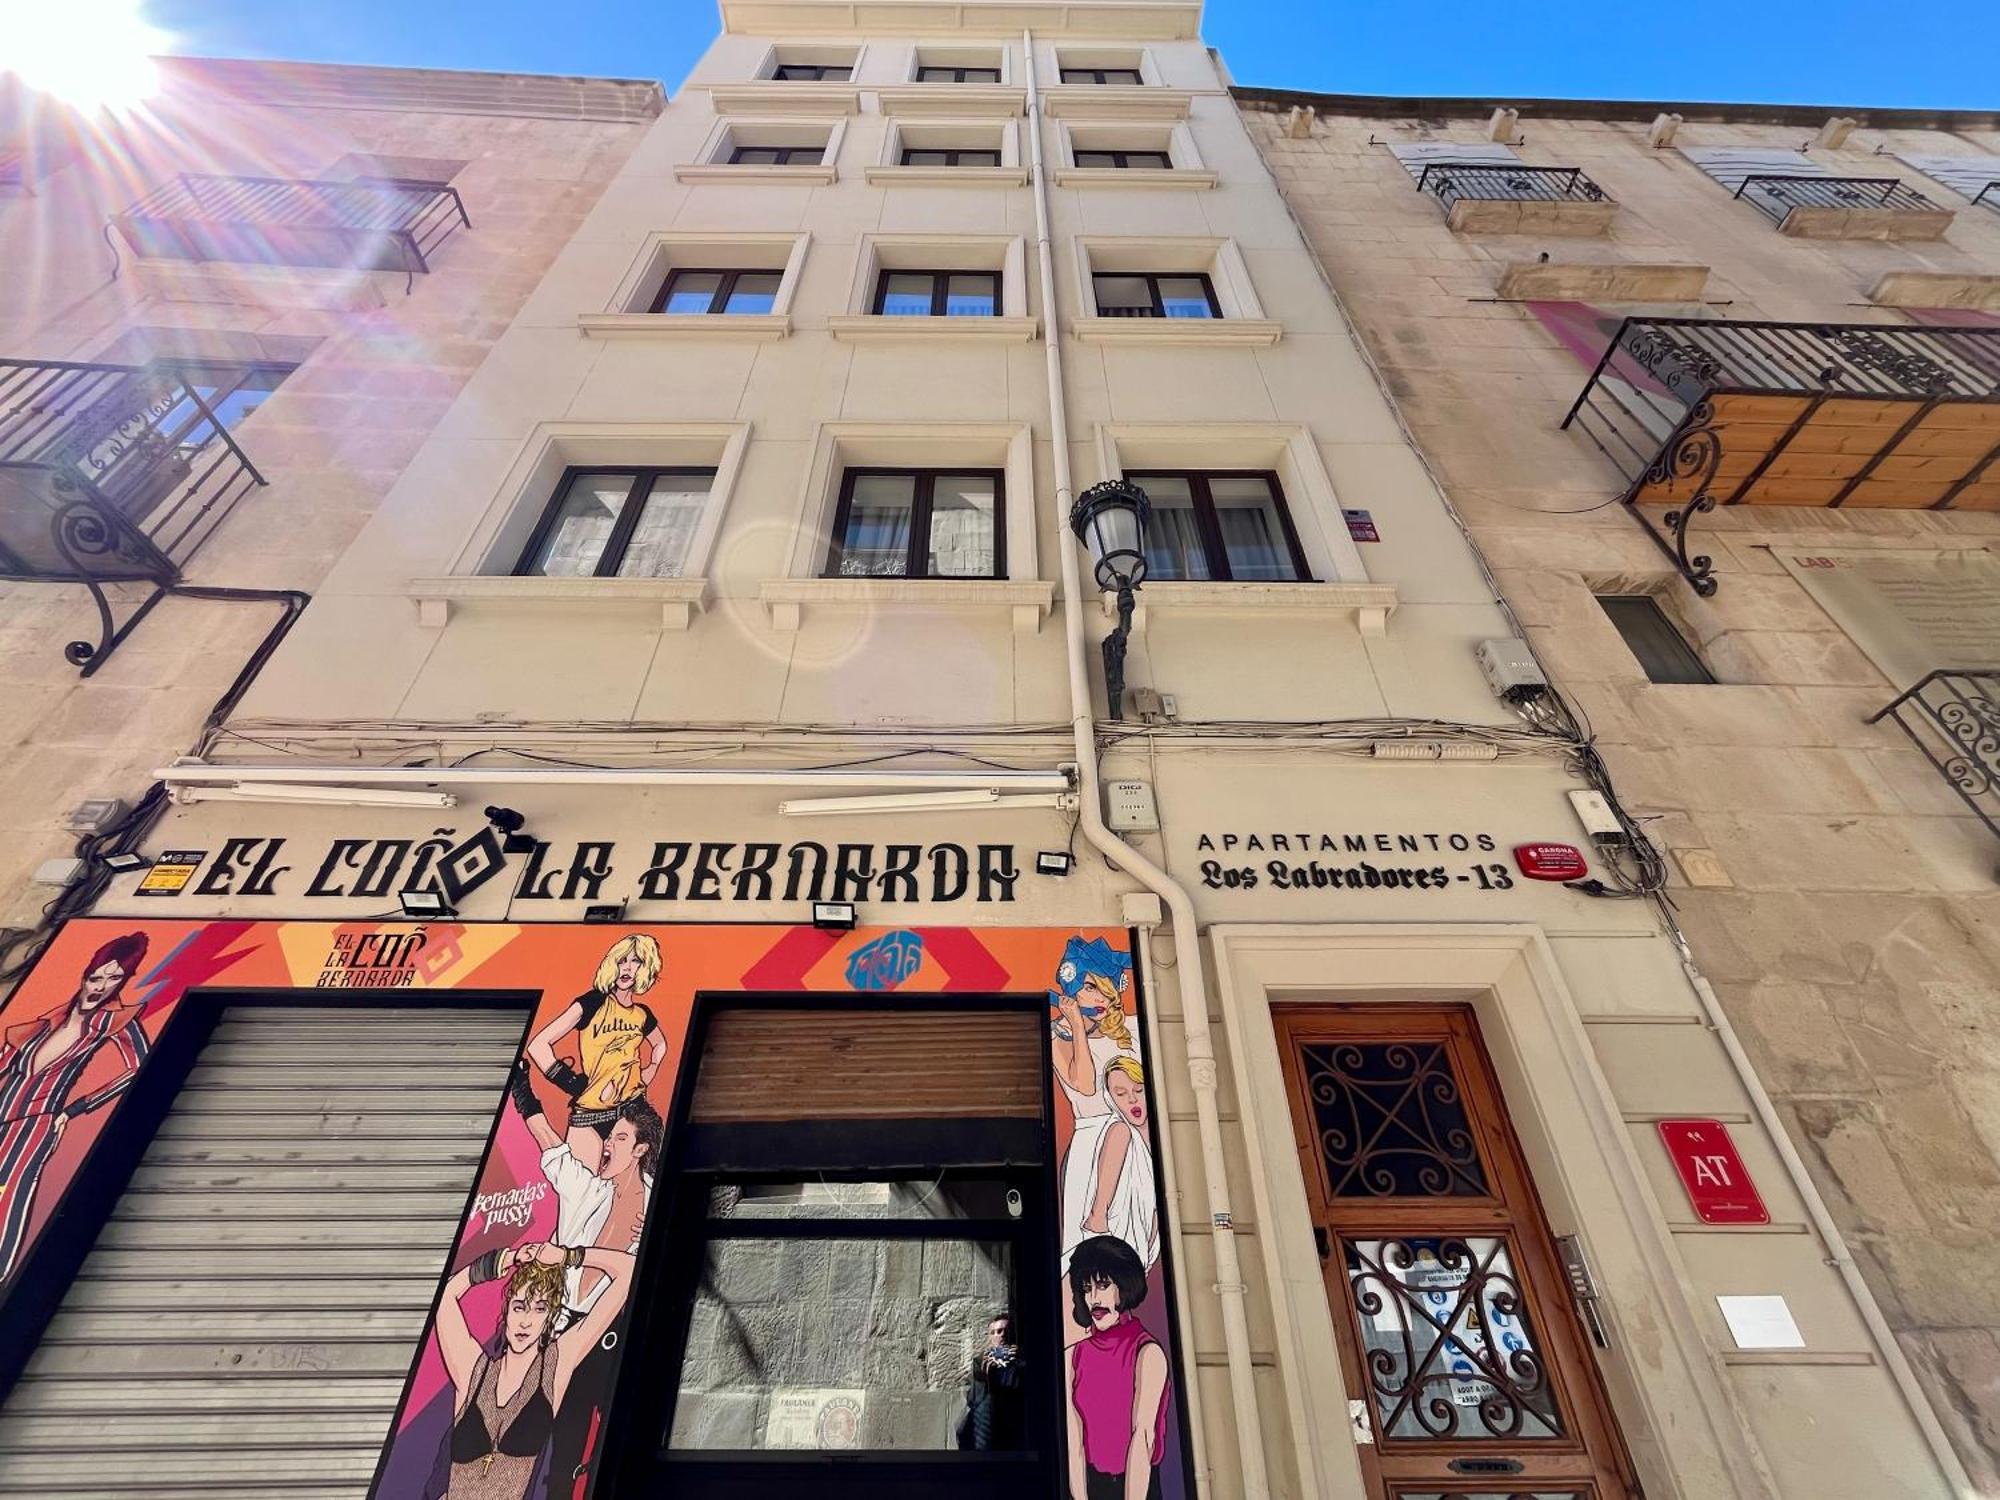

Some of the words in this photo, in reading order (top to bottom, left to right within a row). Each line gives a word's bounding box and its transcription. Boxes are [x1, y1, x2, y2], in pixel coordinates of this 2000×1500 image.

[1197, 833, 1497, 852] APARTAMENTOS
[191, 837, 292, 896] EL
[514, 841, 616, 900] LA
[637, 840, 1020, 903] BERNARDA
[1200, 859, 1258, 890] Los
[1266, 859, 1450, 890] Labradores
[333, 934, 357, 950] EL
[324, 951, 350, 968] LA
[316, 969, 417, 988] BERNARDA
[1689, 1155, 1733, 1187] AT
[483, 1202, 533, 1235] pussy
